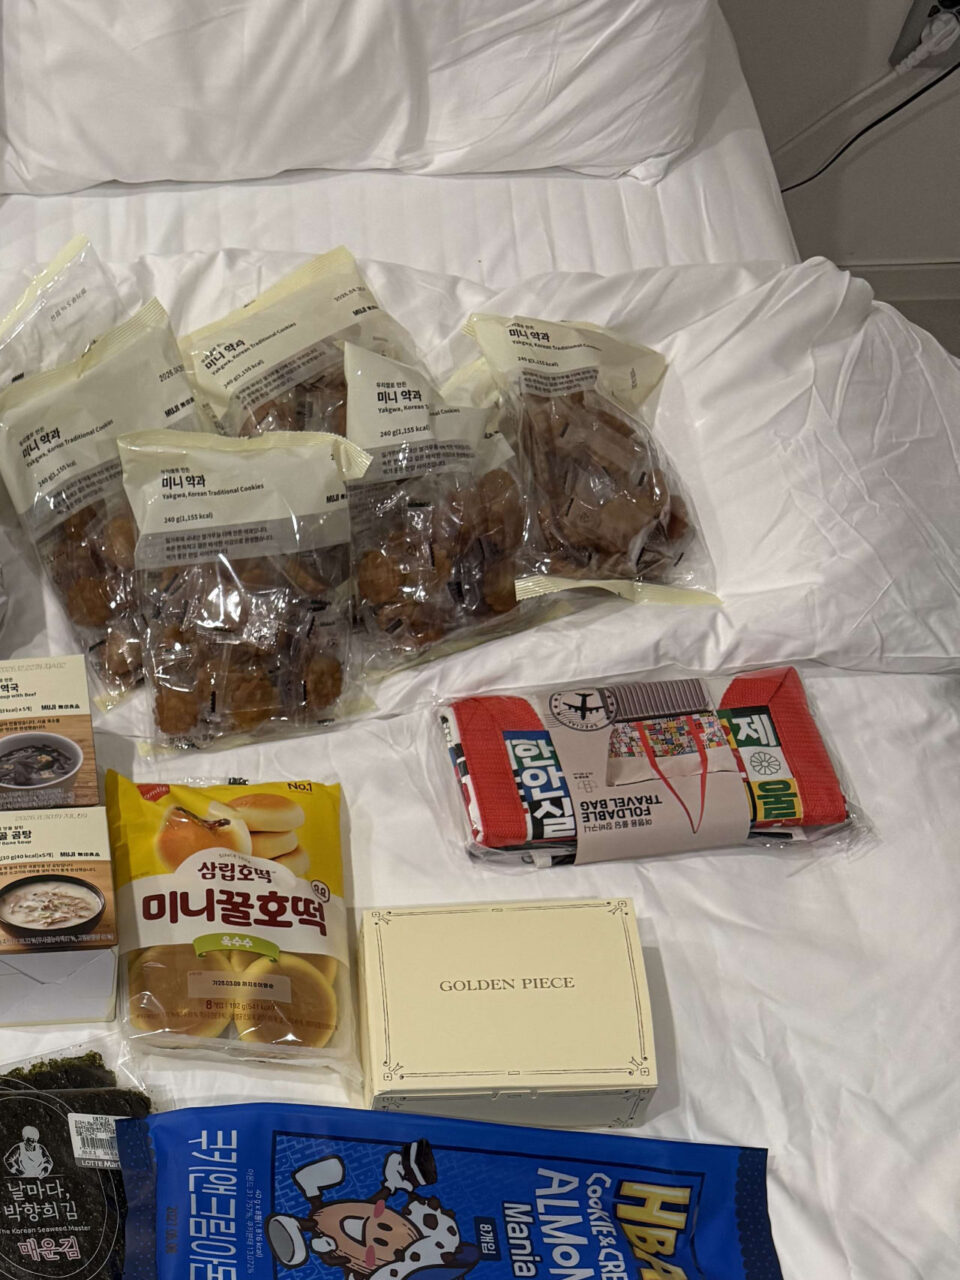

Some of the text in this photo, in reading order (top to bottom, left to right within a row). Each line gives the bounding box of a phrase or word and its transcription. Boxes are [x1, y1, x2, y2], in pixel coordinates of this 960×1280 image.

[377, 390, 422, 403] 미니 약과
[162, 475, 206, 490] 미니 약과
[208, 487, 239, 496] Traditional
[240, 483, 264, 492] Cookies
[288, 782, 314, 793] No.1
[580, 794, 663, 812] TRAVEL BAG
[581, 805, 652, 823] FOLDABLE
[198, 861, 272, 884] 삼립호떡
[142, 888, 328, 936] 미니꿀호떡
[221, 936, 253, 947] 옥수수
[439, 977, 575, 992] GOLDEN PIECE
[7, 1180, 69, 1201] 날마다,
[3, 1200, 78, 1222] 박향희 김
[68, 1224, 91, 1232] Master
[503, 1202, 537, 1278] Mania
